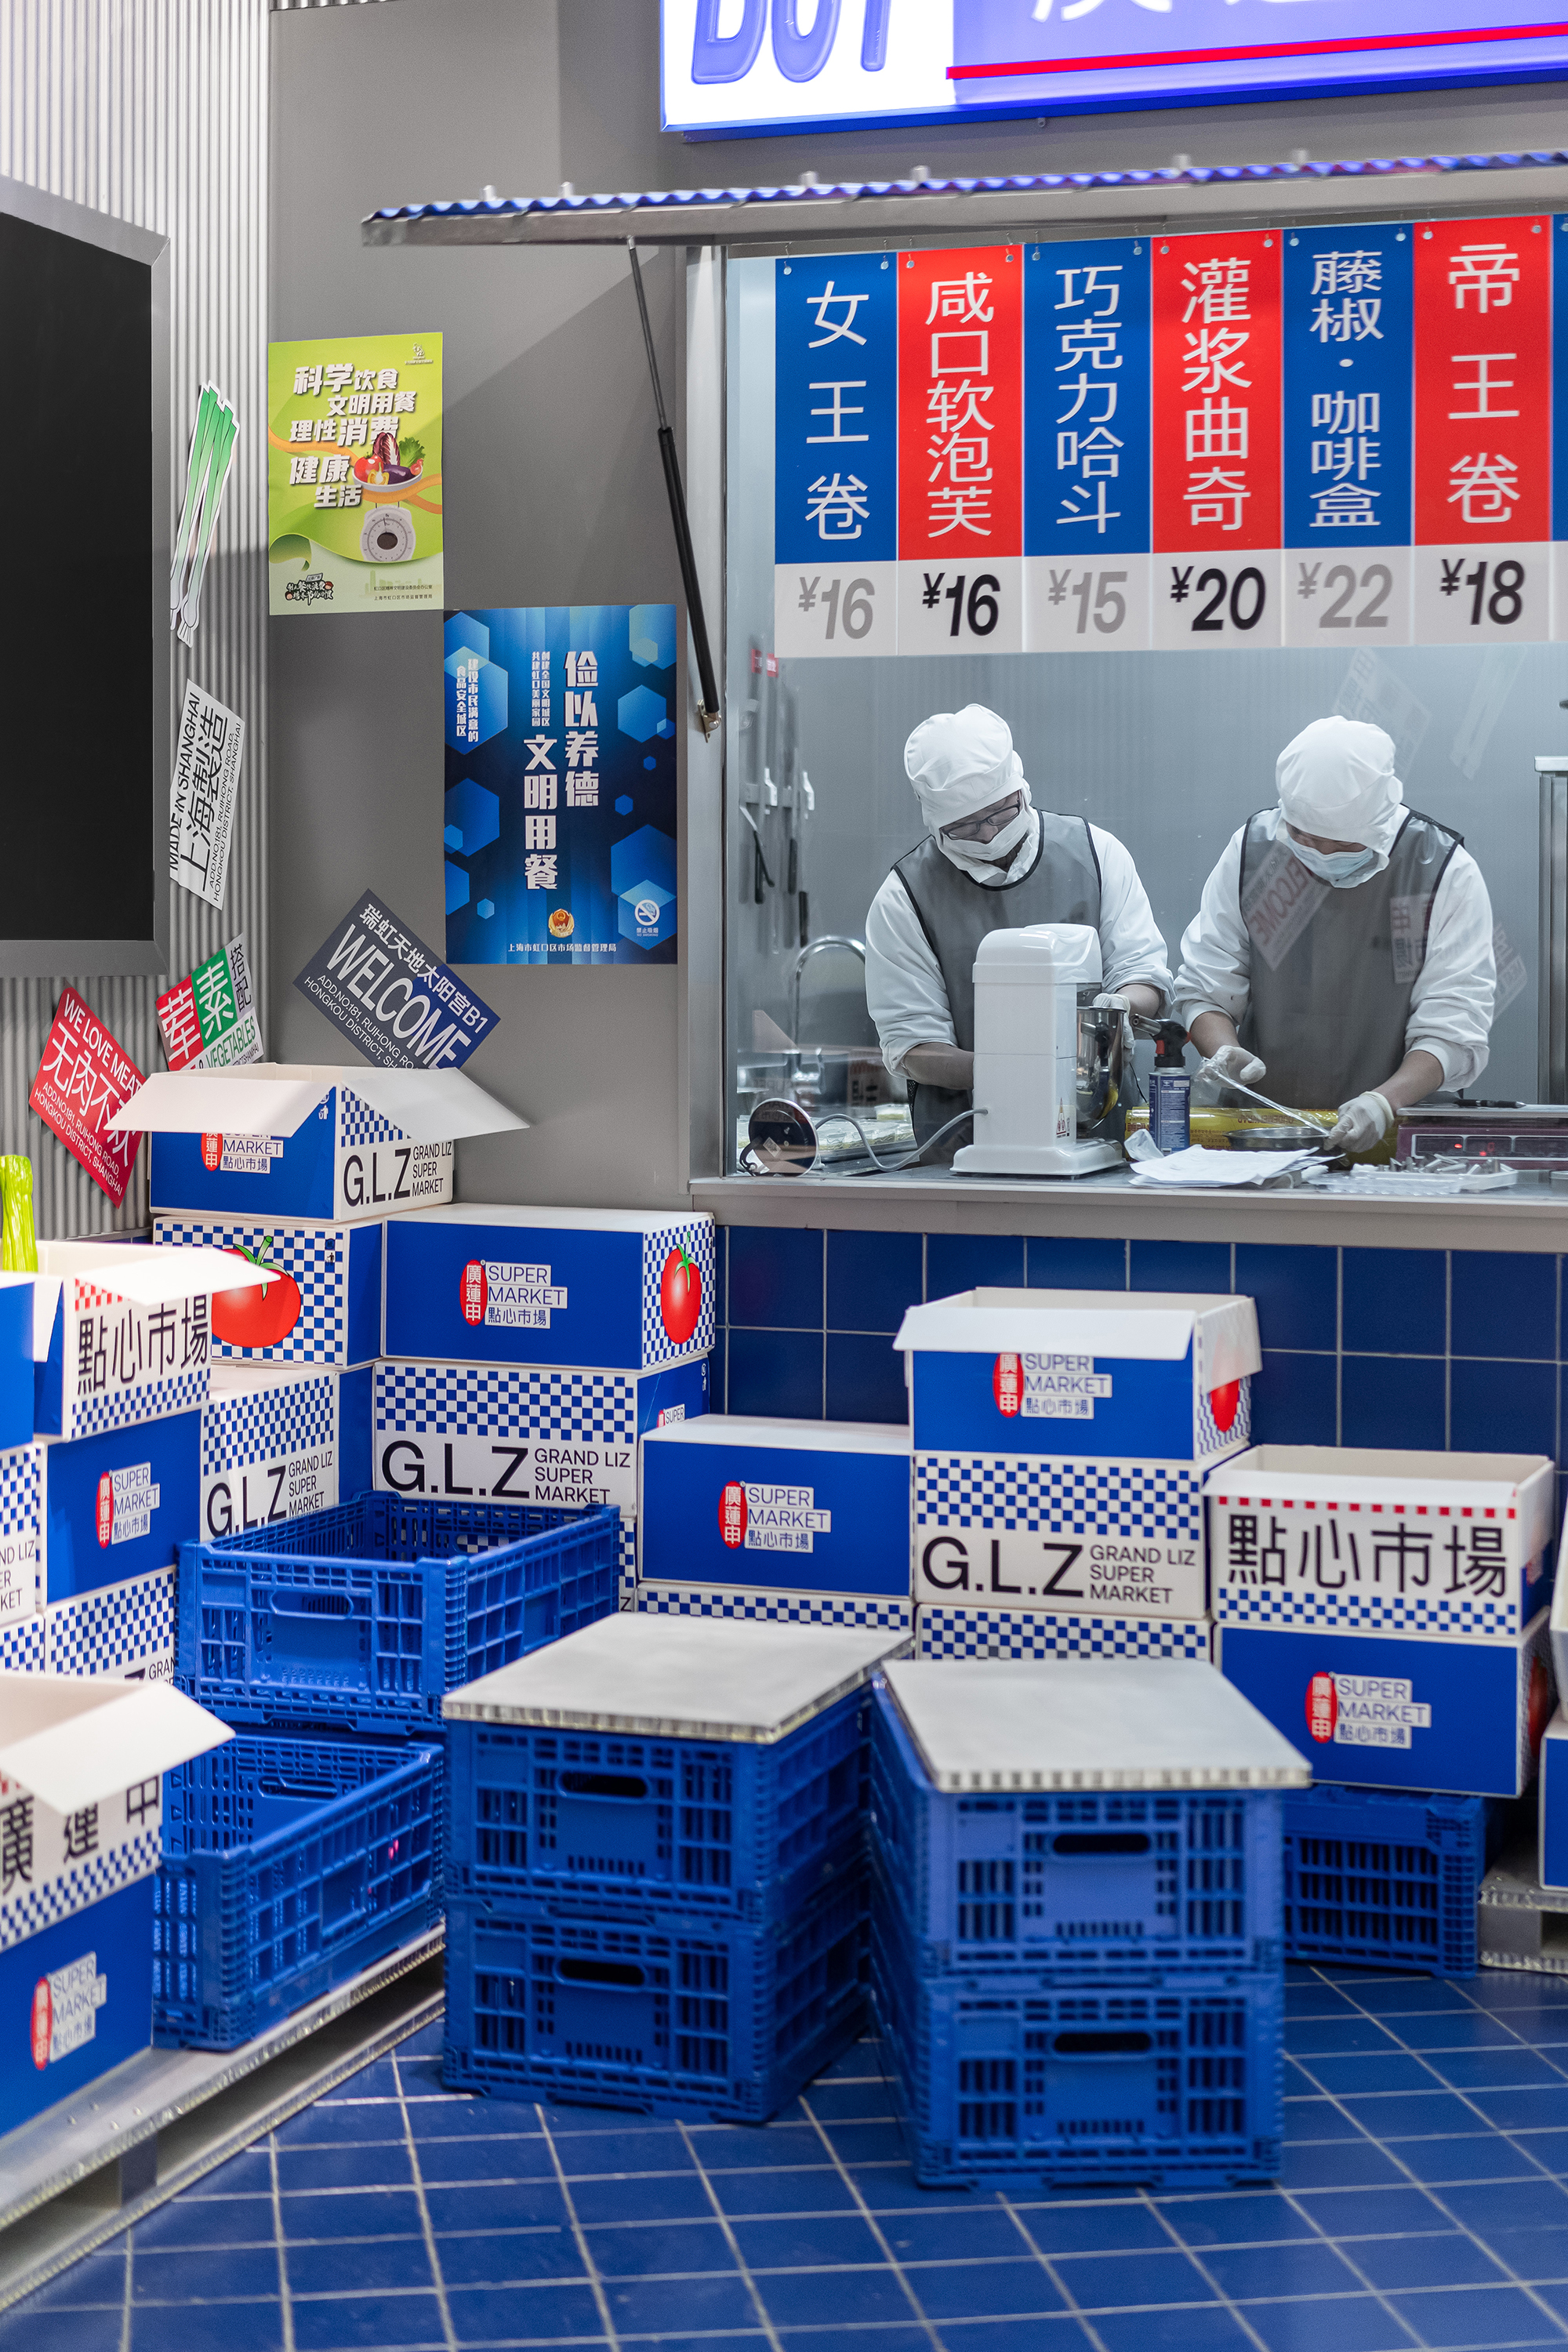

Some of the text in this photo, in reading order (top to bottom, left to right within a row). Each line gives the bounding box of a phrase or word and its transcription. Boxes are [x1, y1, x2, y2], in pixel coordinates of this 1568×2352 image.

[293, 363, 398, 396] 科学饮食
[1054, 265, 1124, 534] 巧克力哈斗
[1181, 256, 1253, 531] 灌浆曲奇
[1446, 242, 1521, 524] 帝王卷
[326, 390, 416, 417] 文明用餐
[805, 281, 869, 540] 女王卷
[925, 271, 995, 538] 咸口软泡芙
[289, 416, 399, 446] 理性消费
[289, 454, 350, 485] 健康
[314, 485, 362, 509] 生活
[798, 576, 875, 641] ¥16
[921, 572, 1001, 637] ¥16
[1047, 568, 1127, 634] ¥15
[1171, 565, 1266, 632] ¥20
[1297, 561, 1392, 629] ¥22
[1439, 557, 1526, 626] ¥18
[456, 666, 466, 737] 食品安全城区
[468, 659, 478, 742] 建设市民满意的
[532, 651, 540, 727] 共建虹口美丽家园
[541, 651, 550, 727] 创建全国文明城区
[564, 651, 599, 807] 俭以养德
[169, 691, 201, 871] MADE IN SHANGHAI
[180, 705, 228, 892] 上海製造
[217, 775, 230, 819] RUIHONG
[213, 840, 226, 902] HONGKOU
[230, 723, 241, 784] SHANGHAI
[524, 734, 557, 890] 文明用餐
[359, 903, 488, 1033] 瑞虹天地太阳宫B1
[508, 943, 617, 953] 上海市虹口区市场监督管理局
[230, 943, 252, 1011] 搭配
[326, 924, 471, 1069] WELCOME
[304, 977, 347, 1021] HONGKOU
[63, 994, 85, 1029] WE
[82, 1018, 113, 1064] LOVE
[204, 1014, 256, 1068] VEGETABLES
[361, 1018, 401, 1058] RUIHONG
[34, 1088, 67, 1129] HONGKOU
[92, 1156, 123, 1197] SHANGHAI
[76, 1119, 103, 1159] RUIHONG
[223, 1139, 281, 1156] MARKET
[413, 1142, 452, 1160] GRAND LIZ
[223, 1156, 267, 1171] 點心市場
[343, 1148, 412, 1207] G.L.Z
[412, 1161, 437, 1178] SUPER
[412, 1178, 444, 1196] MARKET
[466, 1265, 481, 1321] 廣蓮申
[488, 1265, 547, 1283] SUPER
[488, 1286, 564, 1305] MARKET
[488, 1307, 546, 1326] 點心市場
[77, 1294, 209, 1396] 點心市場
[1025, 1353, 1090, 1371] SUPER
[1025, 1376, 1107, 1394] MARKET
[666, 1406, 684, 1424] SUPER
[289, 1450, 332, 1477] GRAND LIZ
[382, 1440, 529, 1499] G.L.Z
[534, 1448, 631, 1468] GRAND LIZ
[534, 1467, 593, 1484] SUPER
[114, 1467, 149, 1492] SUPER
[289, 1475, 316, 1497] SUPER
[535, 1485, 611, 1504] MARKET
[749, 1487, 810, 1506] SUPER
[114, 1488, 158, 1517] MARKET
[207, 1465, 287, 1538] G.L.Z
[289, 1491, 325, 1516] MARKET
[724, 1486, 741, 1544] 廣蓮申
[749, 1508, 828, 1528] MARKET
[18, 1541, 35, 1561] LIZ
[749, 1530, 808, 1549] 點心市場
[1090, 1544, 1196, 1566] GRAND LIZ
[1229, 1514, 1508, 1598] 點心市場
[922, 1536, 1083, 1598] G.L.Z
[1090, 1564, 1154, 1583] SUPER
[1090, 1584, 1174, 1603] MARKET
[1338, 1678, 1406, 1699] SUPER
[1338, 1701, 1426, 1723] MARKET
[53, 1959, 94, 1999] SUPER
[53, 1980, 102, 2025] MARKET
